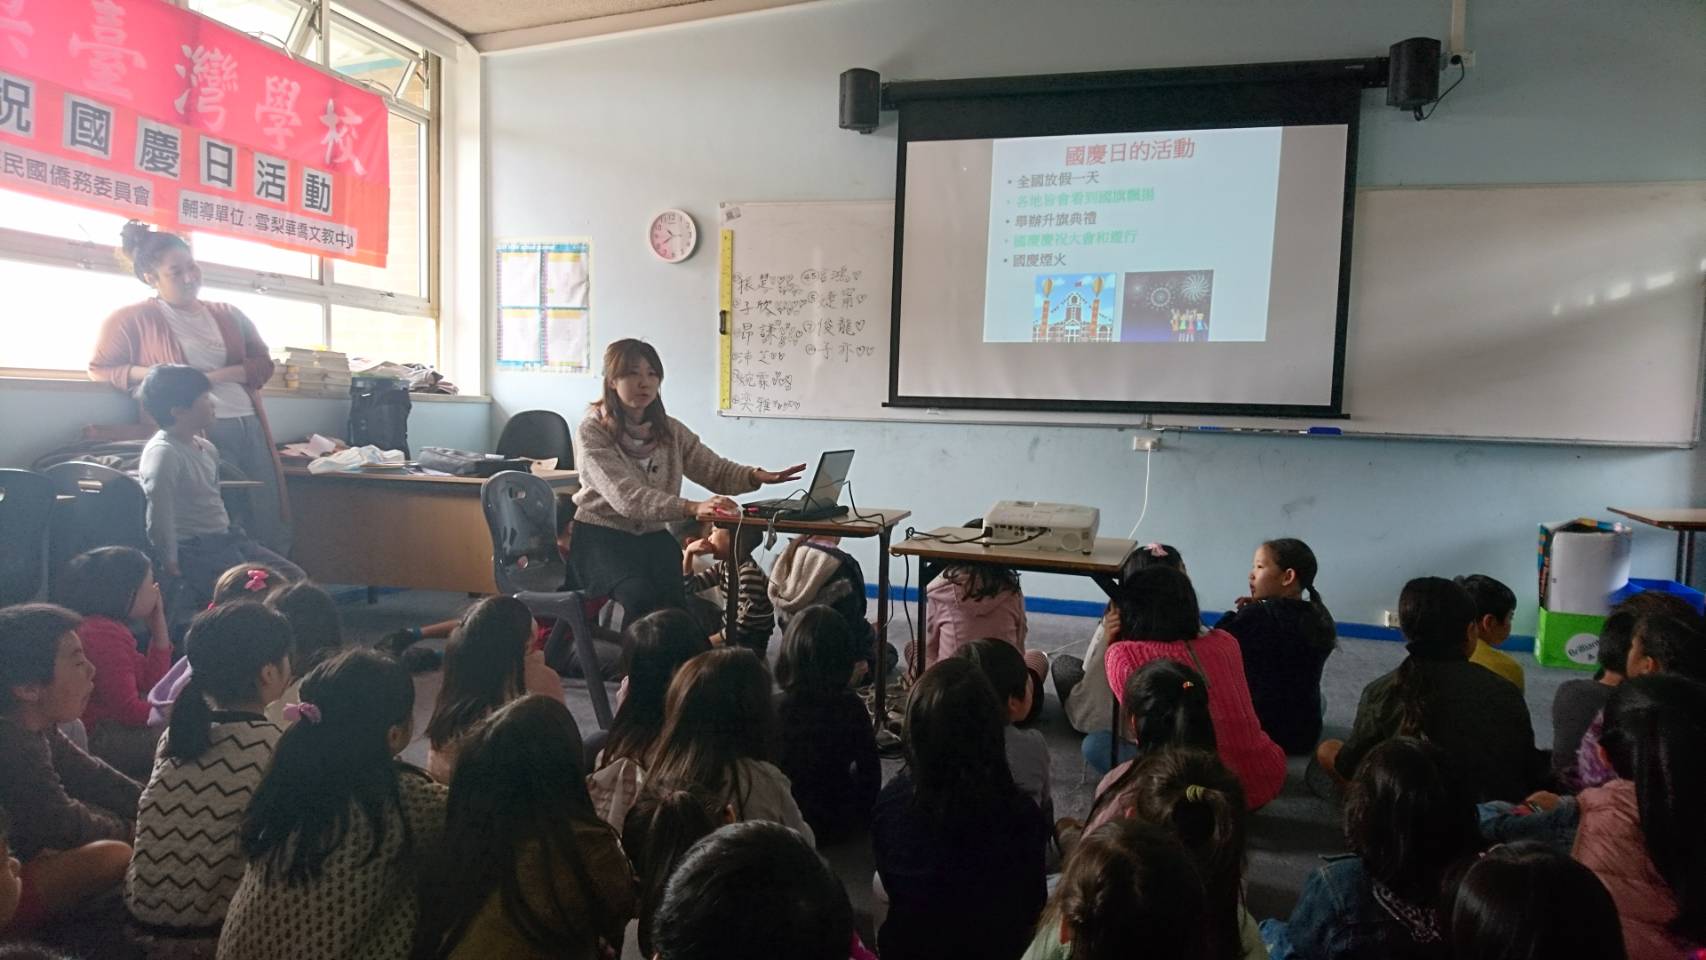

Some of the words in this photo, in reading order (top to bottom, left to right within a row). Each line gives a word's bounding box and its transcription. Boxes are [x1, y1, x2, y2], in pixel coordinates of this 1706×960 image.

[1065, 137, 1196, 167] 國慶日的活動
[0, 151, 151, 208] 民國僑務委員會
[1016, 170, 1100, 190] 全國放假一天
[1014, 210, 1098, 229] 舉辦升旗典禮
[1012, 252, 1068, 268] 國慶煙火
